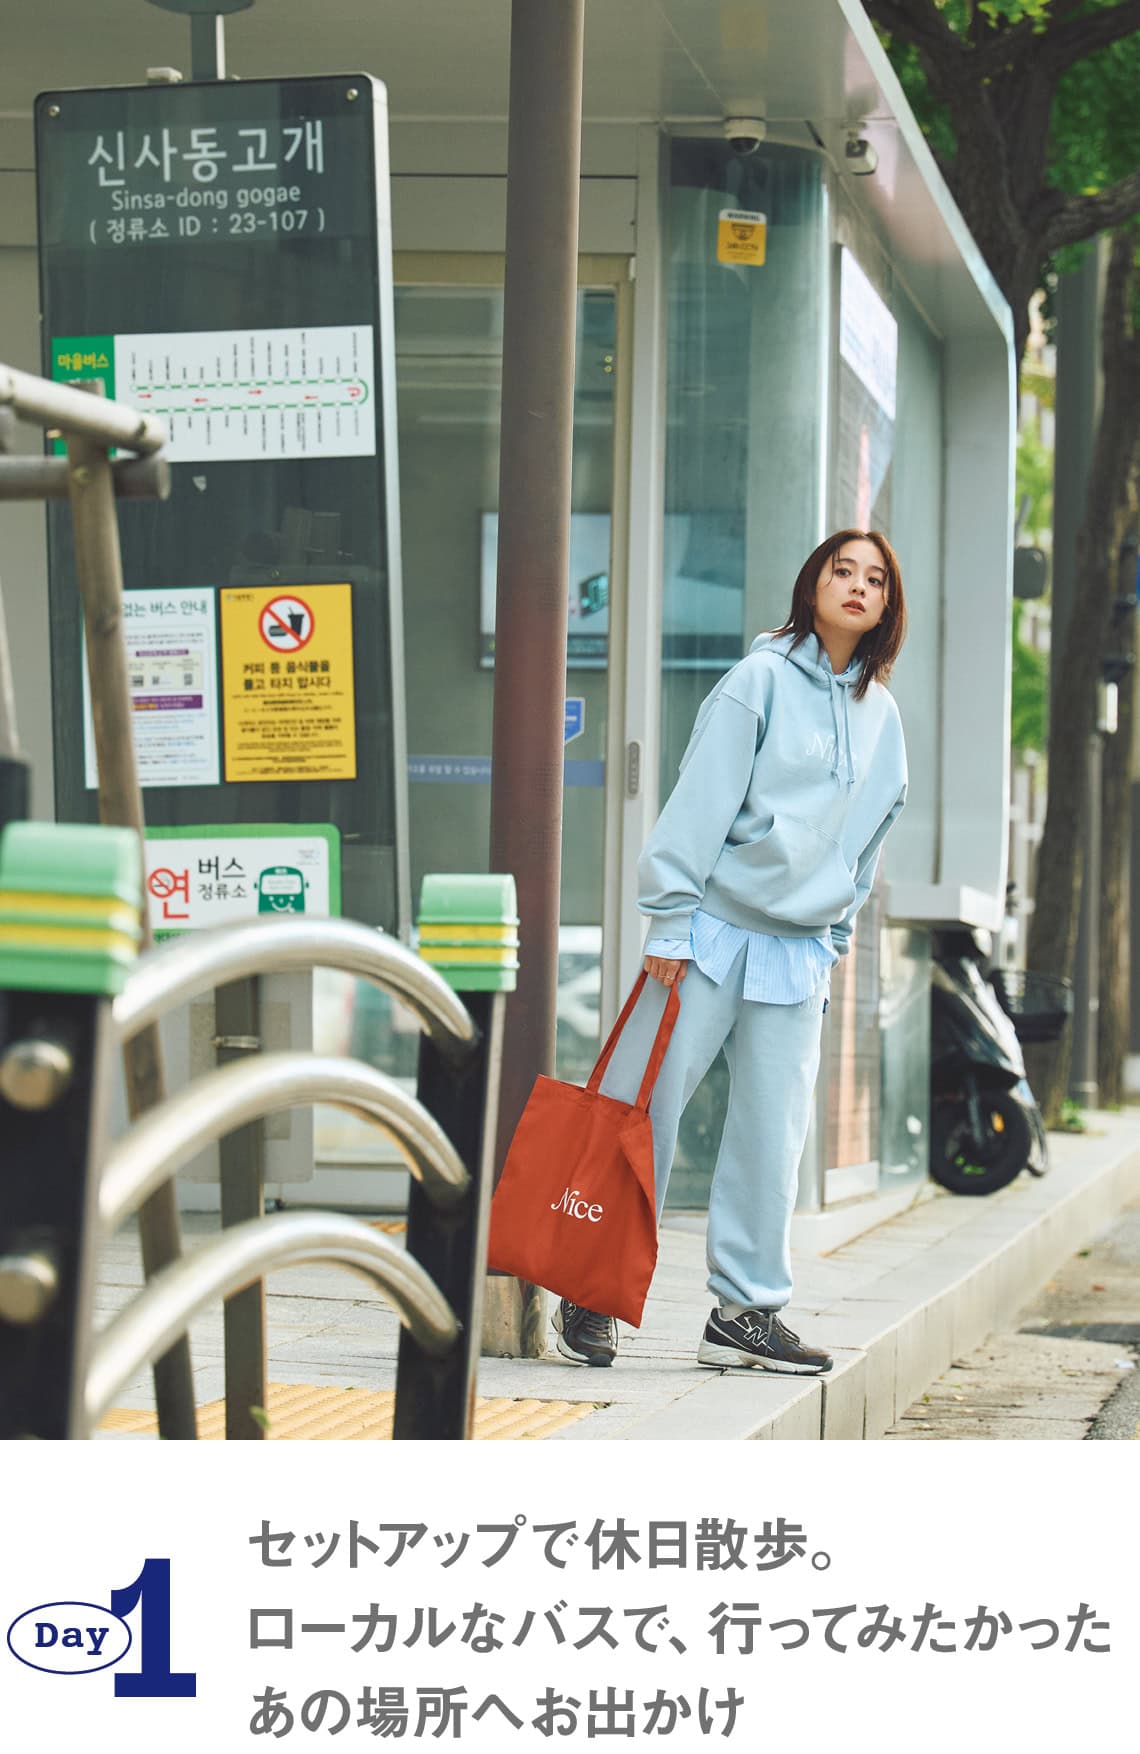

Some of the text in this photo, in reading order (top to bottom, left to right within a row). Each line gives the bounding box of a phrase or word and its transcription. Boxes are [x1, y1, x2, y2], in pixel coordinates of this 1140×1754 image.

[88, 118, 325, 188] 신사동고개
[111, 183, 301, 211] Sinsa-dong gogae
[106, 218, 170, 243] 정류소
[179, 215, 201, 236] ID
[229, 210, 308, 234] 23-107
[57, 351, 110, 371] 마을버스
[150, 600, 177, 616] 버스
[180, 599, 208, 616] 안내
[243, 662, 265, 674] 커피
[198, 856, 246, 881] 버스
[197, 883, 248, 902] 정류소
[550, 1186, 603, 1223] Nice
